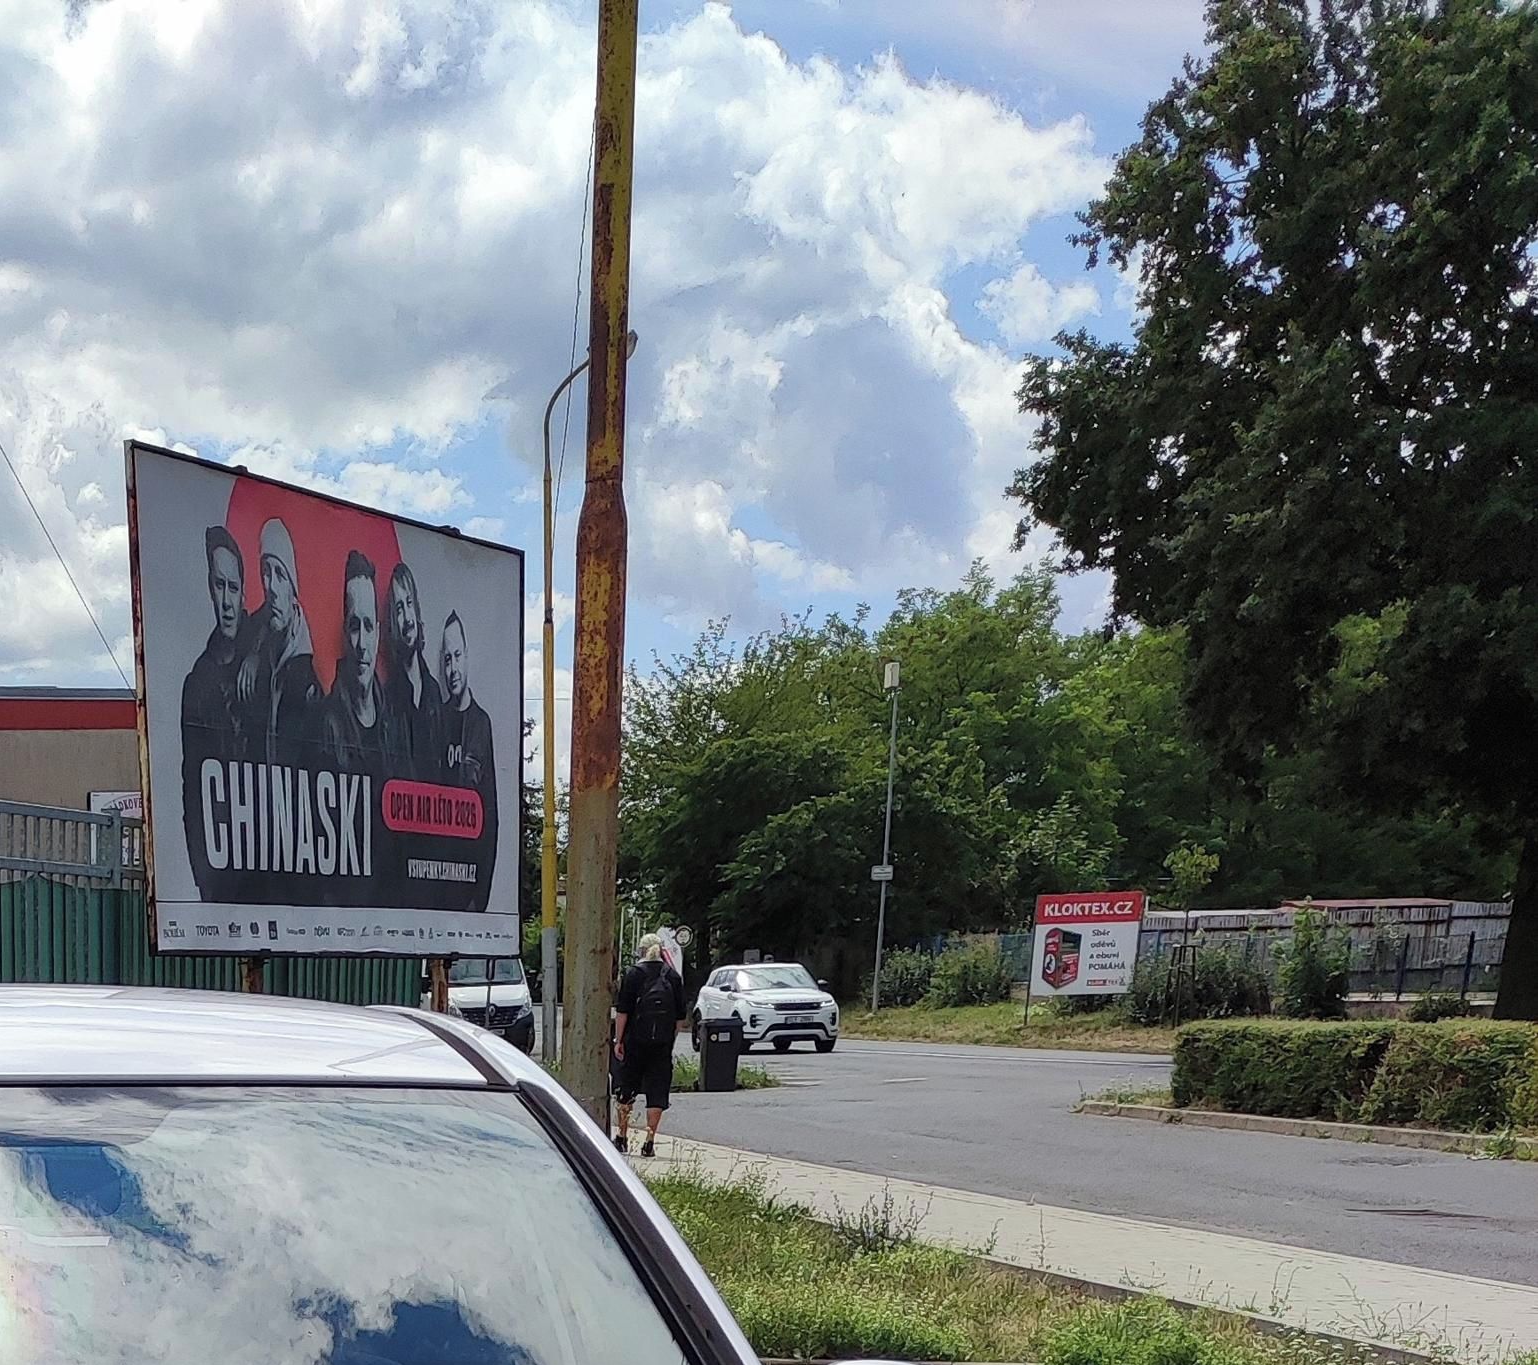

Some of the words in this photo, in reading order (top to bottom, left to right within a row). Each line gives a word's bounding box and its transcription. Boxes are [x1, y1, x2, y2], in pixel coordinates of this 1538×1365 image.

[201, 758, 372, 876] CHINASKI
[390, 791, 413, 822] OPEN
[416, 795, 431, 824] AIR
[434, 793, 453, 826] LÉTO
[1044, 901, 1134, 917] KLOKTEX.CZ
[1088, 961, 1126, 970] POMÁHÁ
